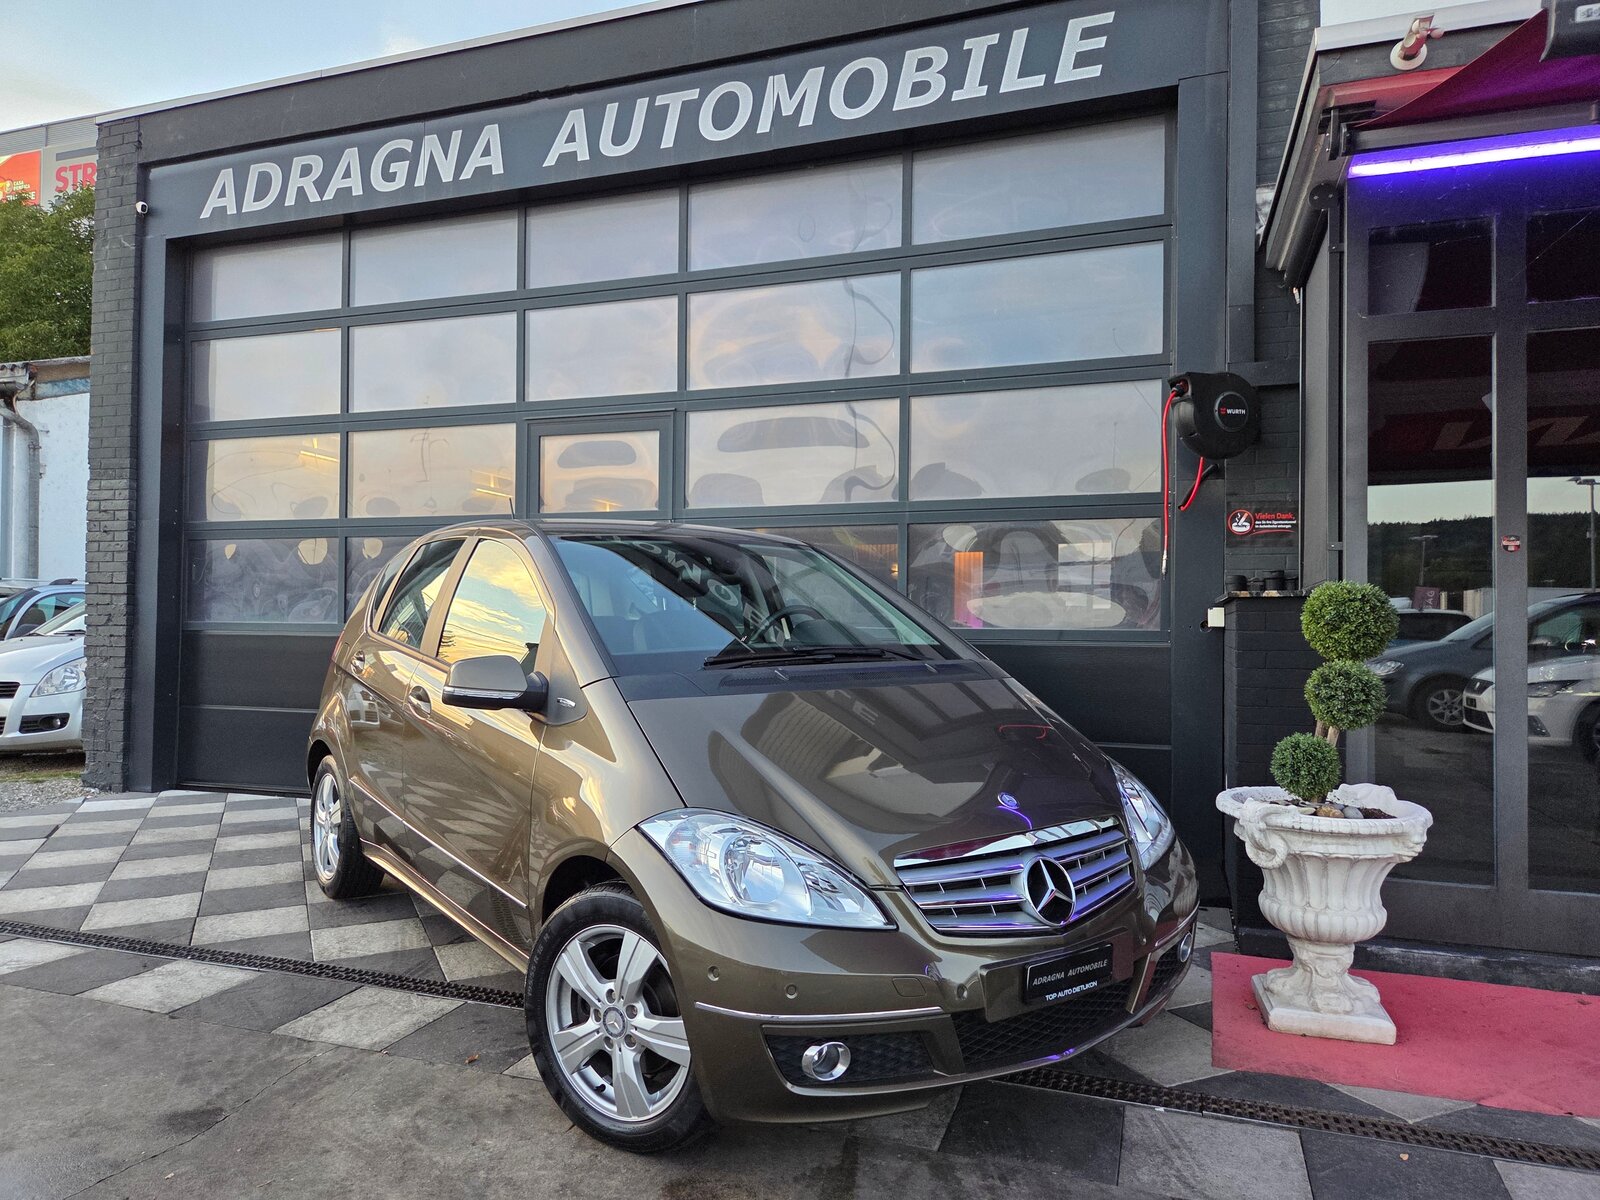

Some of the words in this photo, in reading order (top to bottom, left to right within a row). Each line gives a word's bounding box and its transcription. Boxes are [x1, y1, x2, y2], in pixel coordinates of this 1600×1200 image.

[200, 124, 504, 219] ADRAGNA
[543, 11, 1115, 167] AUTOMOBILE
[1032, 971, 1065, 986] ADRAGNA
[1067, 959, 1108, 977] AUTOMOBILE
[1057, 988, 1072, 998] AUTO
[1072, 981, 1098, 994] DIETLIKON
